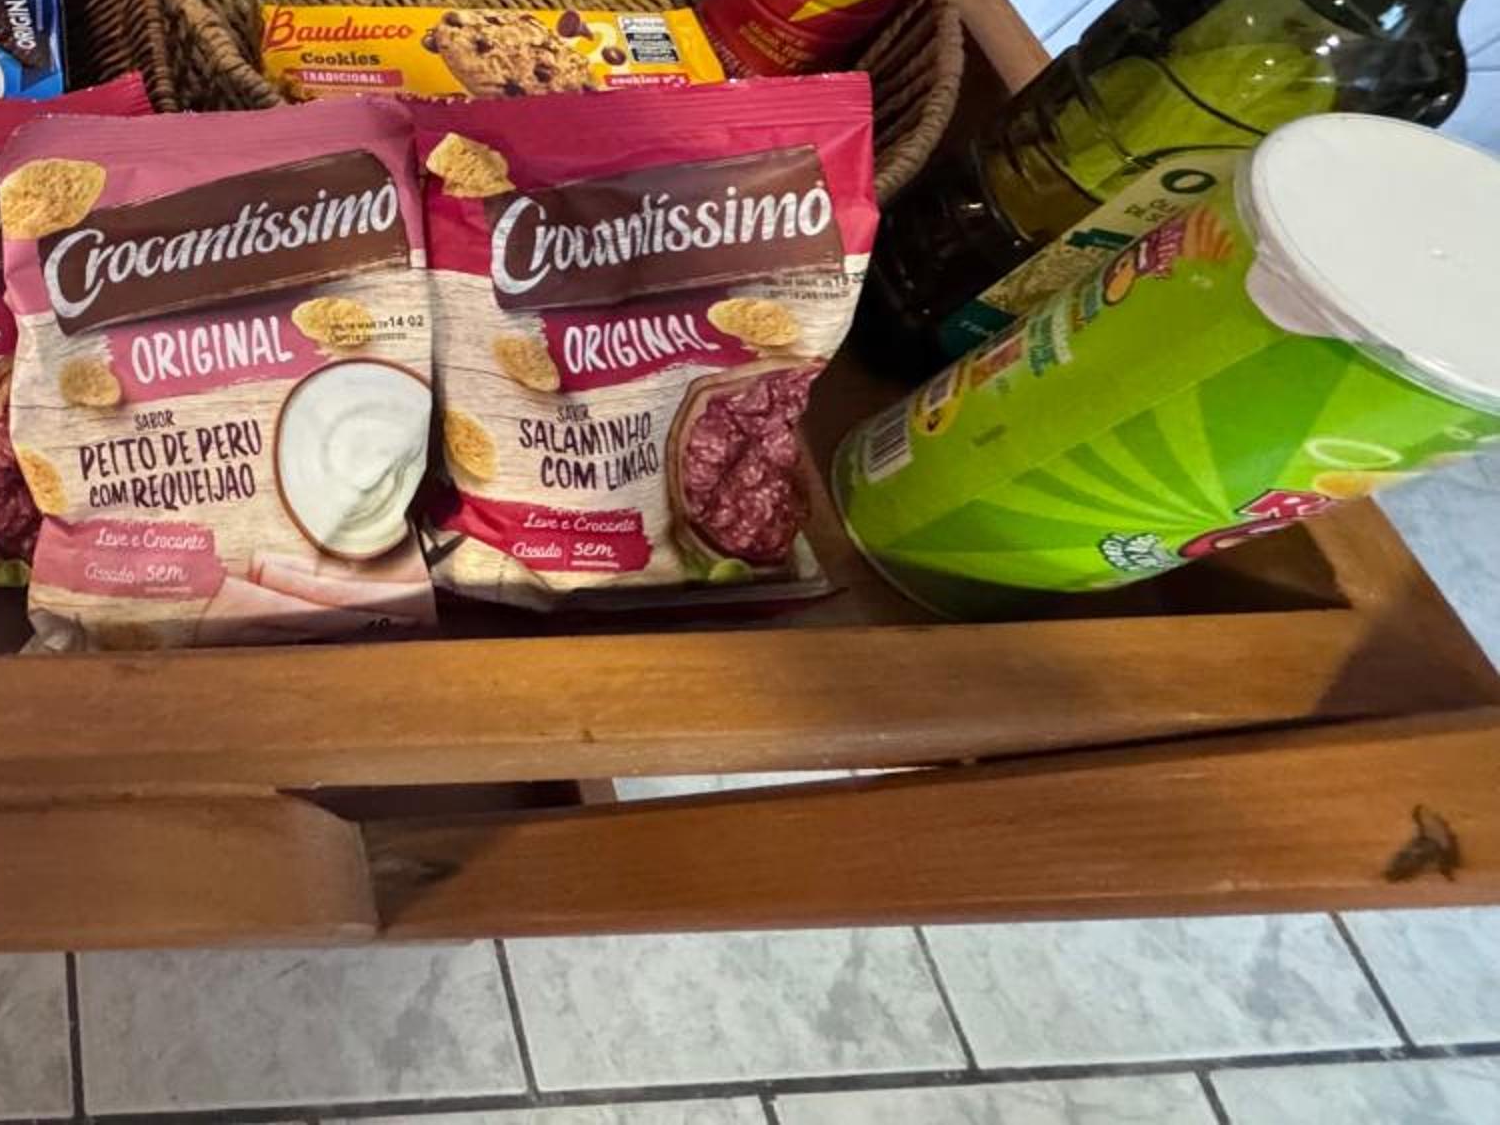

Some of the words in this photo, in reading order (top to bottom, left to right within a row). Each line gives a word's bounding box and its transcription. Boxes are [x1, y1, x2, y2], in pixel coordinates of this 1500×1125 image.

[264, 6, 413, 49] Bauducco
[302, 51, 380, 66] Cookies
[302, 71, 385, 83] TRADICIONAL
[43, 184, 398, 318] Crocantíssimo
[491, 181, 832, 295] Crocantíssimo
[132, 316, 294, 385] ORIGINAL
[564, 314, 720, 374] ORIGINAL
[134, 410, 175, 431] SABOR
[519, 412, 652, 456] SALAMINHO
[79, 436, 156, 481] PEITO
[161, 431, 193, 467] DE
[196, 419, 262, 463] PERU
[541, 455, 597, 490] COM
[604, 441, 660, 491] LIMÃO
[89, 480, 128, 508] COM
[131, 461, 257, 511] REQUEIJÃO
[95, 528, 129, 547] Leve
[131, 535, 140, 546] e
[143, 528, 208, 550] Crocante
[523, 512, 558, 529] Leve
[560, 519, 571, 530] e
[573, 516, 638, 532] Crocante
[572, 541, 617, 558] sem
[147, 563, 189, 582] sem
